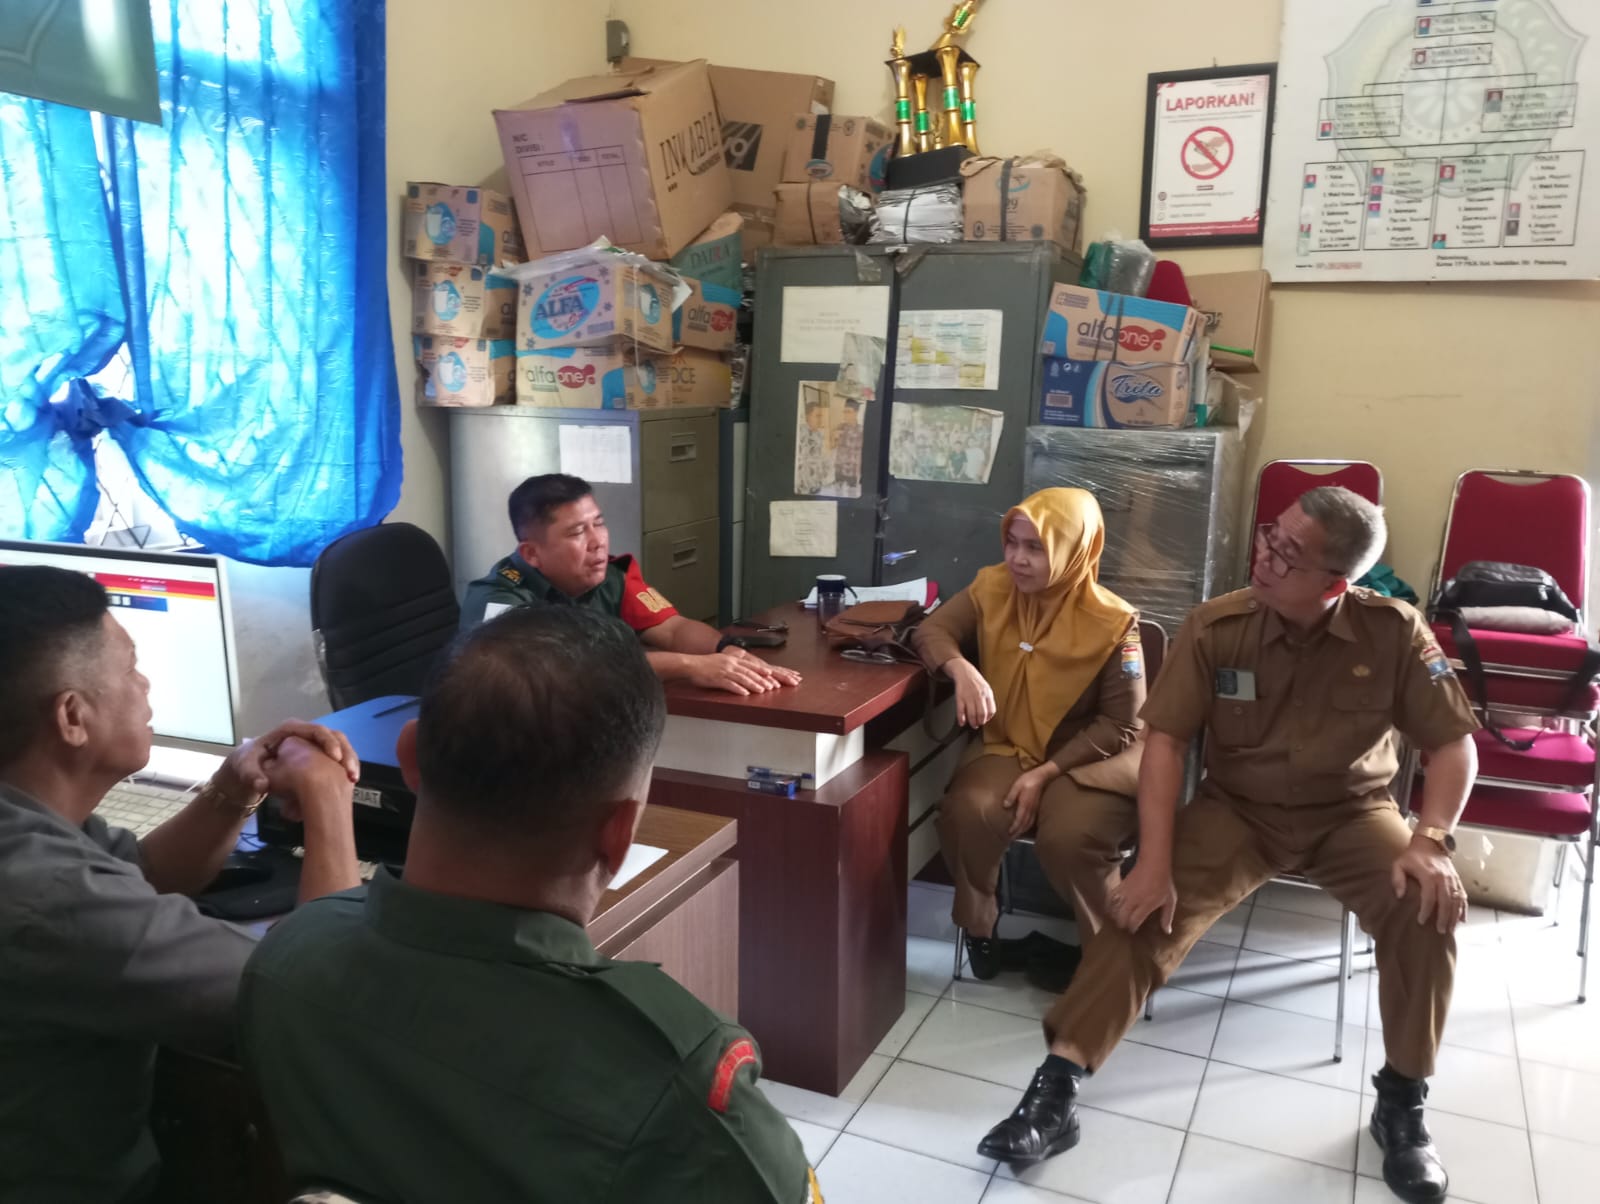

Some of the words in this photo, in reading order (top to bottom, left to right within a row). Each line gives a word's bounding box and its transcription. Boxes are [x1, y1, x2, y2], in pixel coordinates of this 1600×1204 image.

[1166, 93, 1255, 112] LAPORKAN!
[535, 295, 585, 320] ALFA
[354, 789, 379, 804] RIAT
